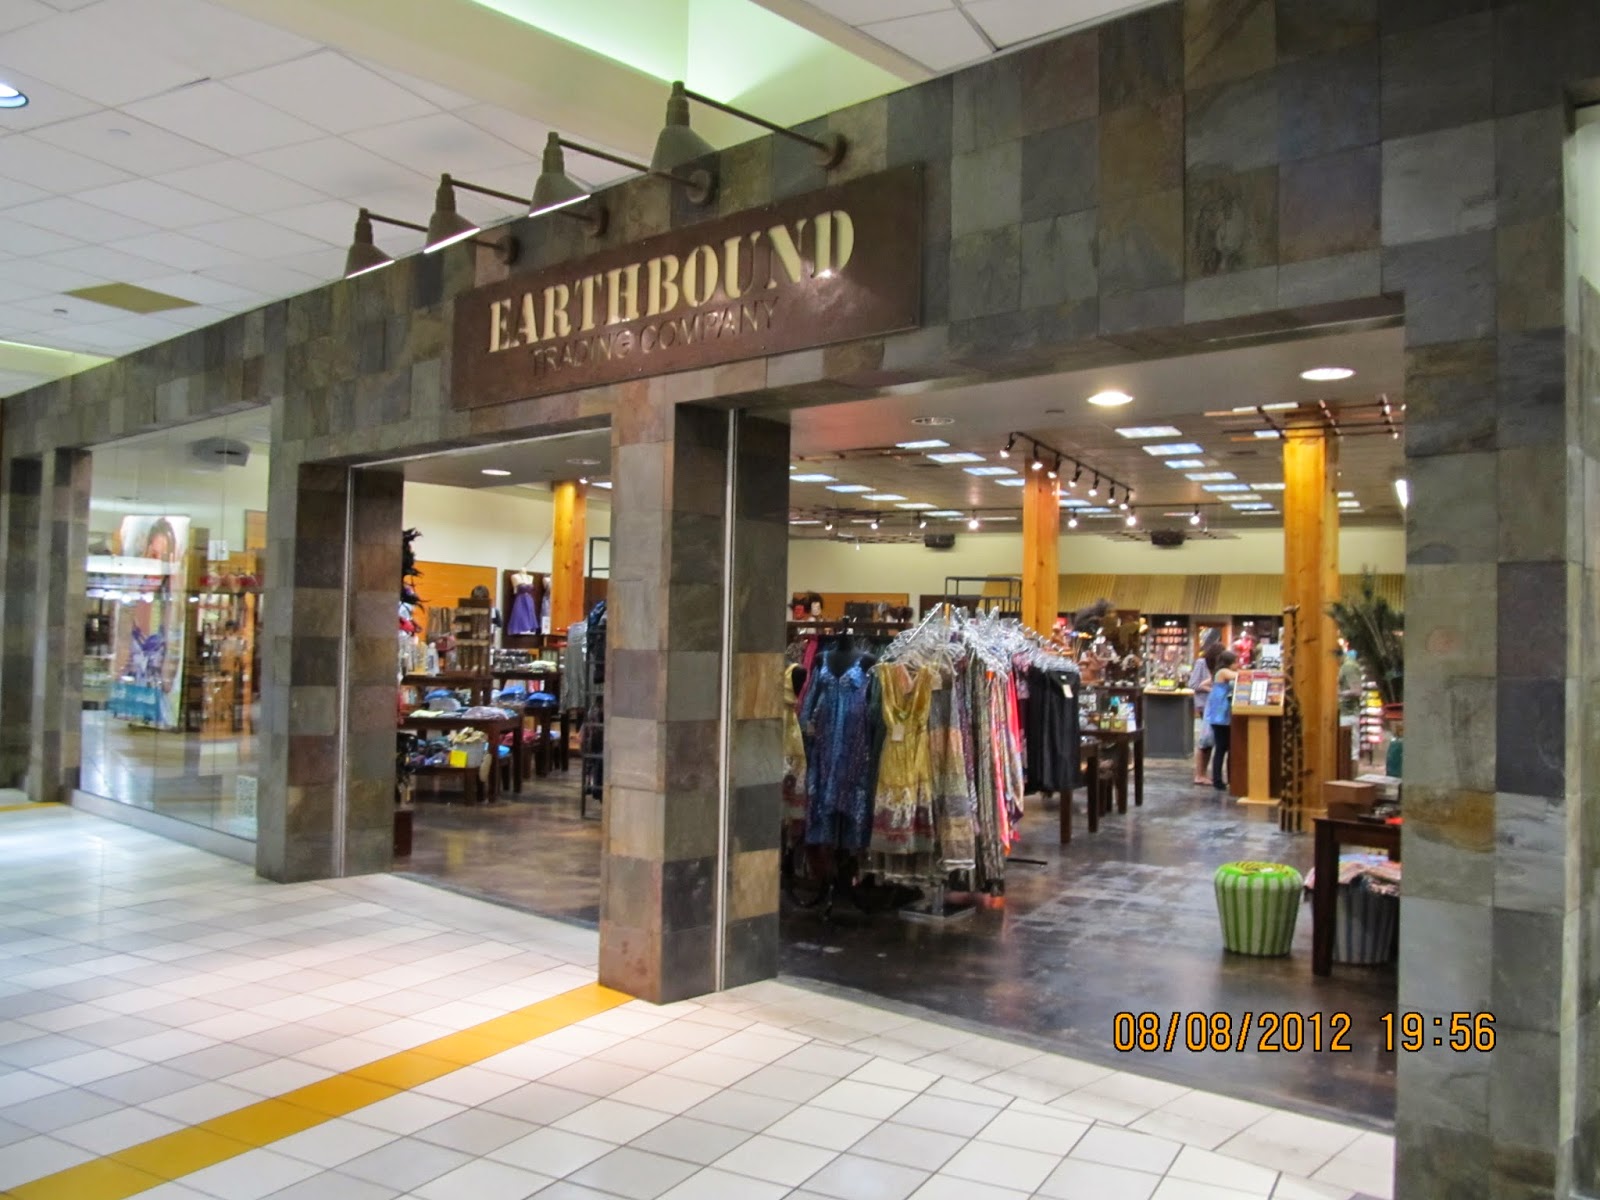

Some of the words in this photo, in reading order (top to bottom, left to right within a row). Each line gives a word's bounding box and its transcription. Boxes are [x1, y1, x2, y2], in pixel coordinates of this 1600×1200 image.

[488, 209, 855, 354] EARTHBOUND
[533, 329, 635, 377] TRADING
[639, 296, 780, 355] COMPANY
